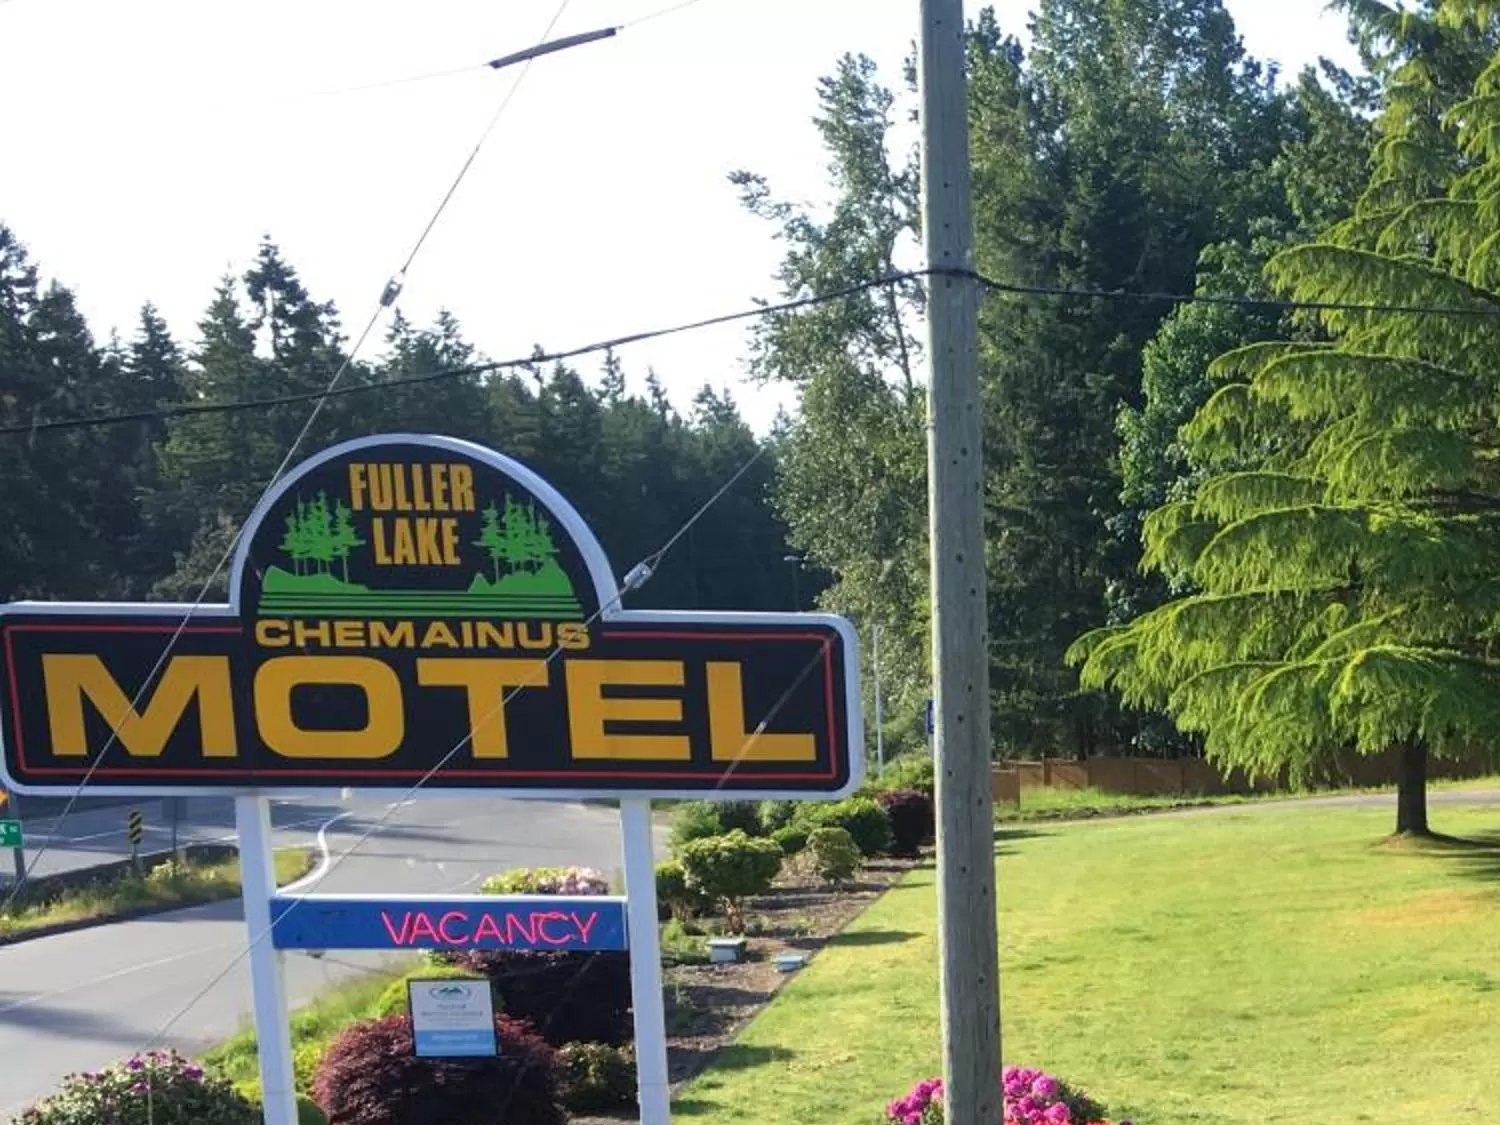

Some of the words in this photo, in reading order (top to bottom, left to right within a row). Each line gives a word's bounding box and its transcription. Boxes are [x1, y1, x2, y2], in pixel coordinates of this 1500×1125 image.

[350, 463, 475, 511] FULLER
[372, 517, 461, 565] LAKE
[255, 618, 590, 649] CHEMAINUS
[42, 653, 816, 761] MOTEL
[381, 911, 597, 944] VACANCY
